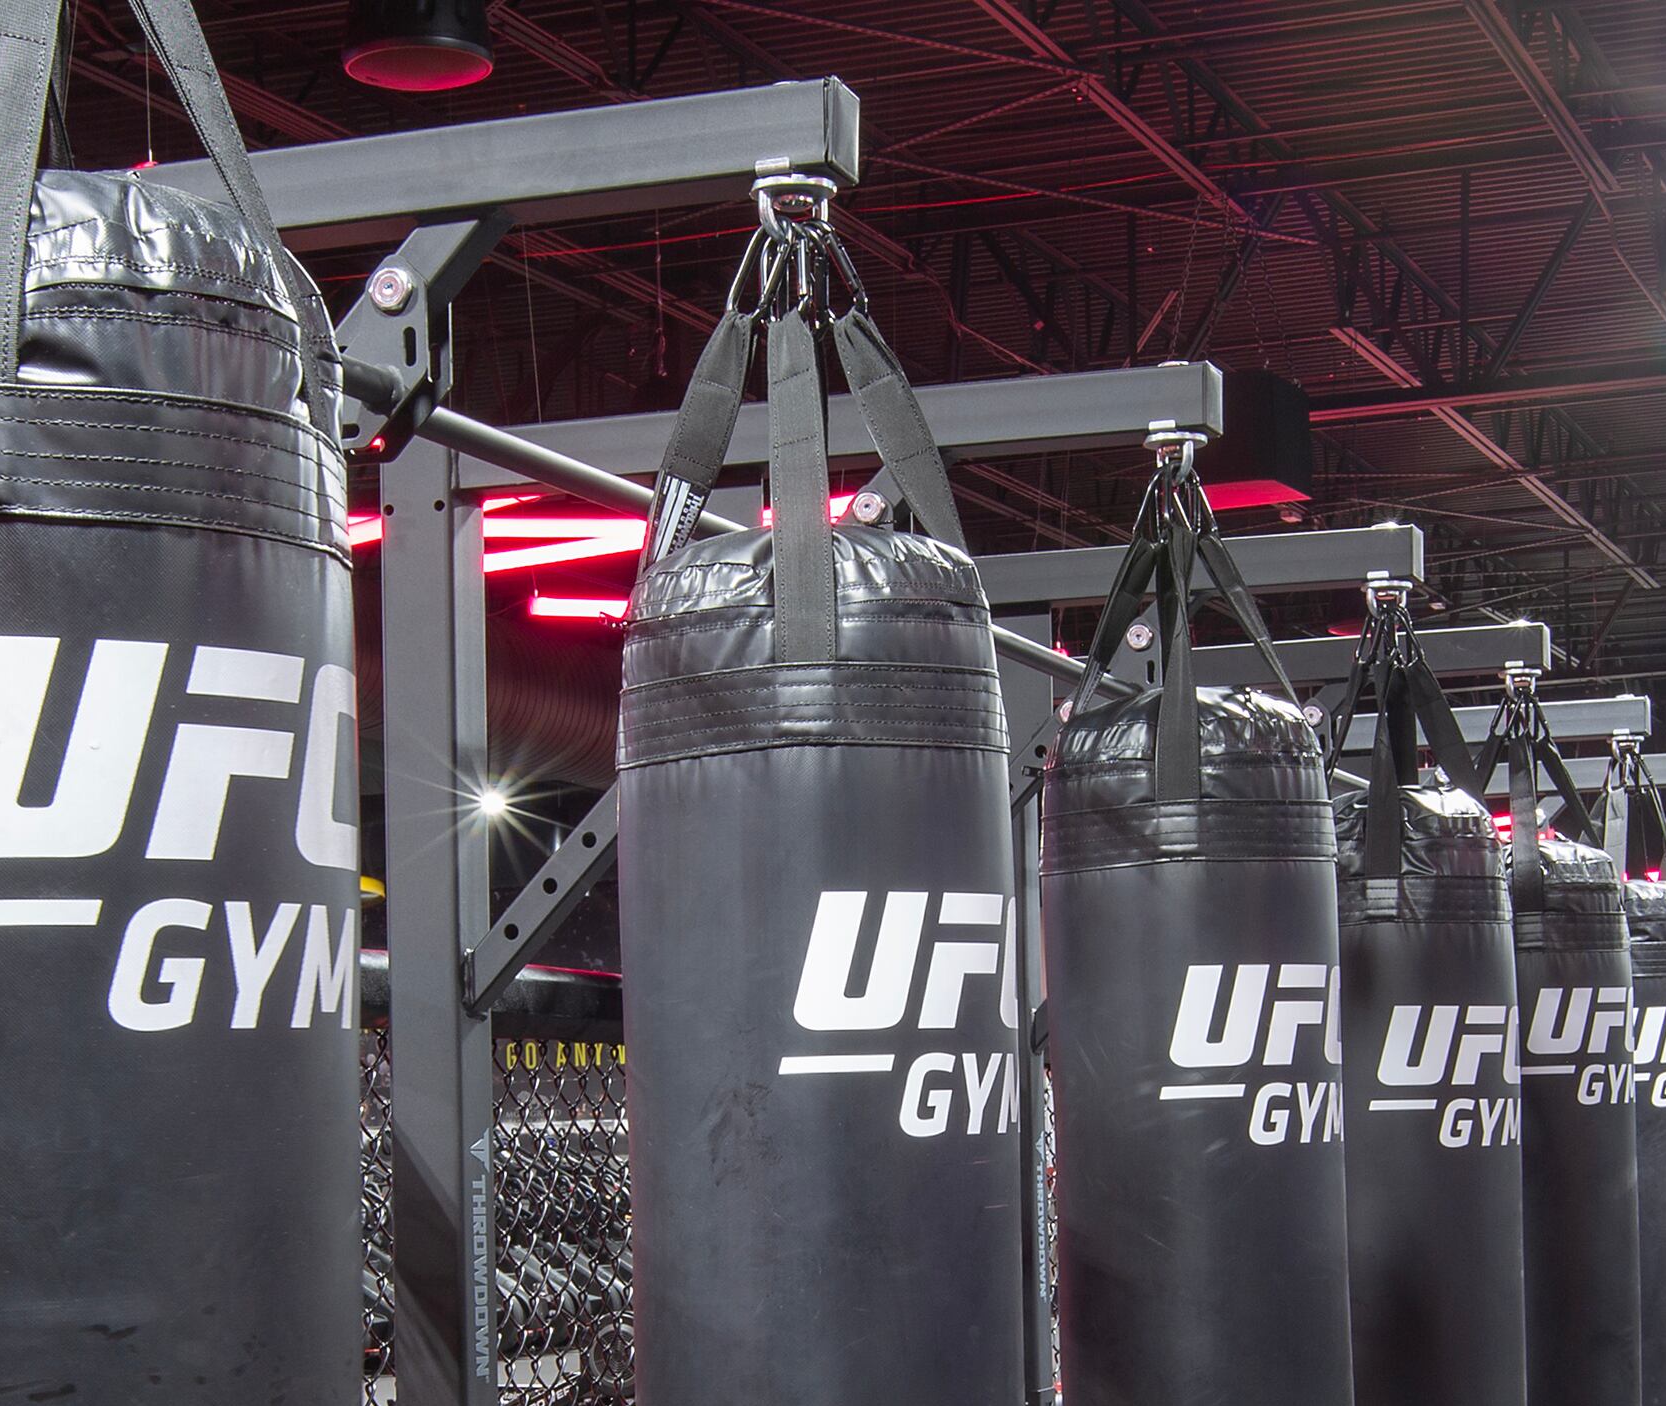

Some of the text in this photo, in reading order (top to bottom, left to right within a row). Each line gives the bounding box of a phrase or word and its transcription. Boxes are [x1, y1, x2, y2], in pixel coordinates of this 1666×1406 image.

[108, 898, 355, 1031] GYM
[506, 1043, 537, 1070] GO
[472, 1174, 489, 1377] THROWDOWN
[1036, 1162, 1047, 1298] THROWDOWN
